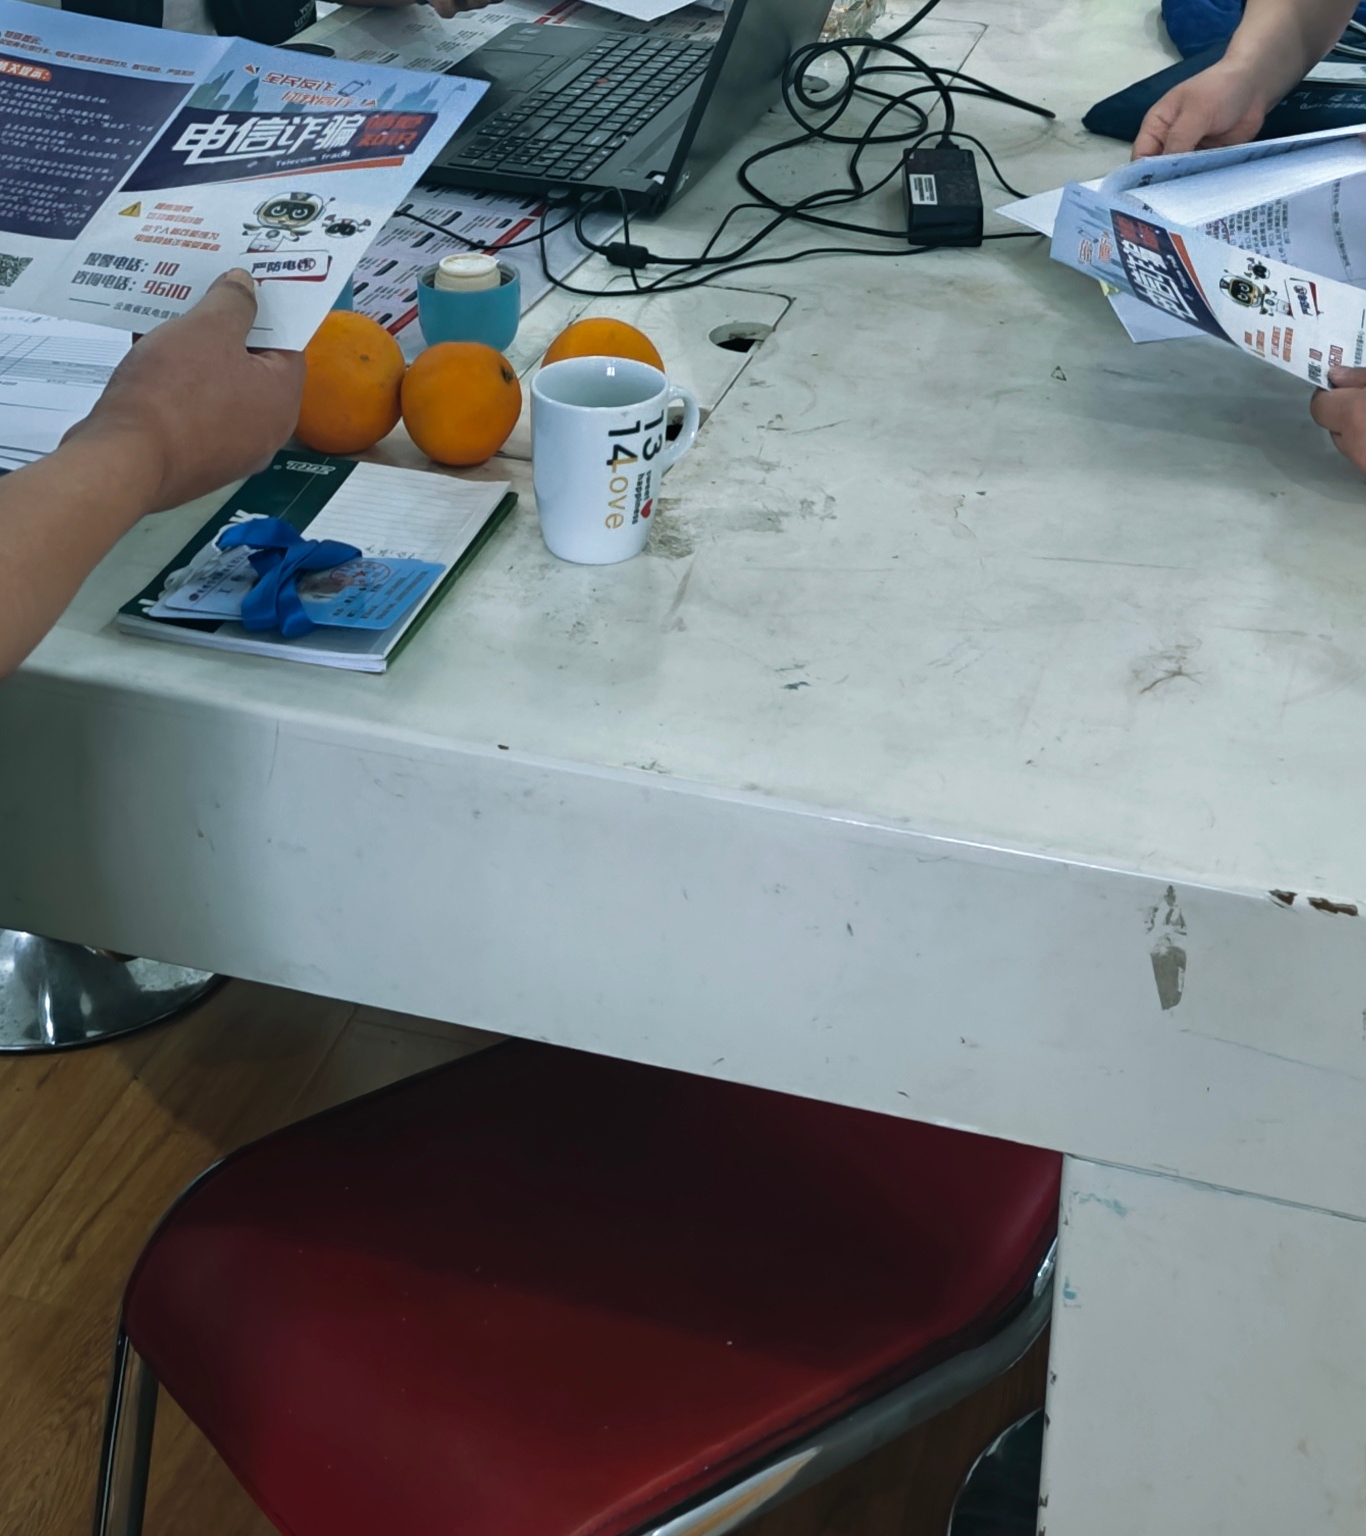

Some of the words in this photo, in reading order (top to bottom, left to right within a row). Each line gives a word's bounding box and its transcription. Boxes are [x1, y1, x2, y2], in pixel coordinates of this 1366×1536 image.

[172, 114, 367, 165] 电信诈骗
[152, 260, 181, 277] 110
[140, 280, 193, 301] 96110
